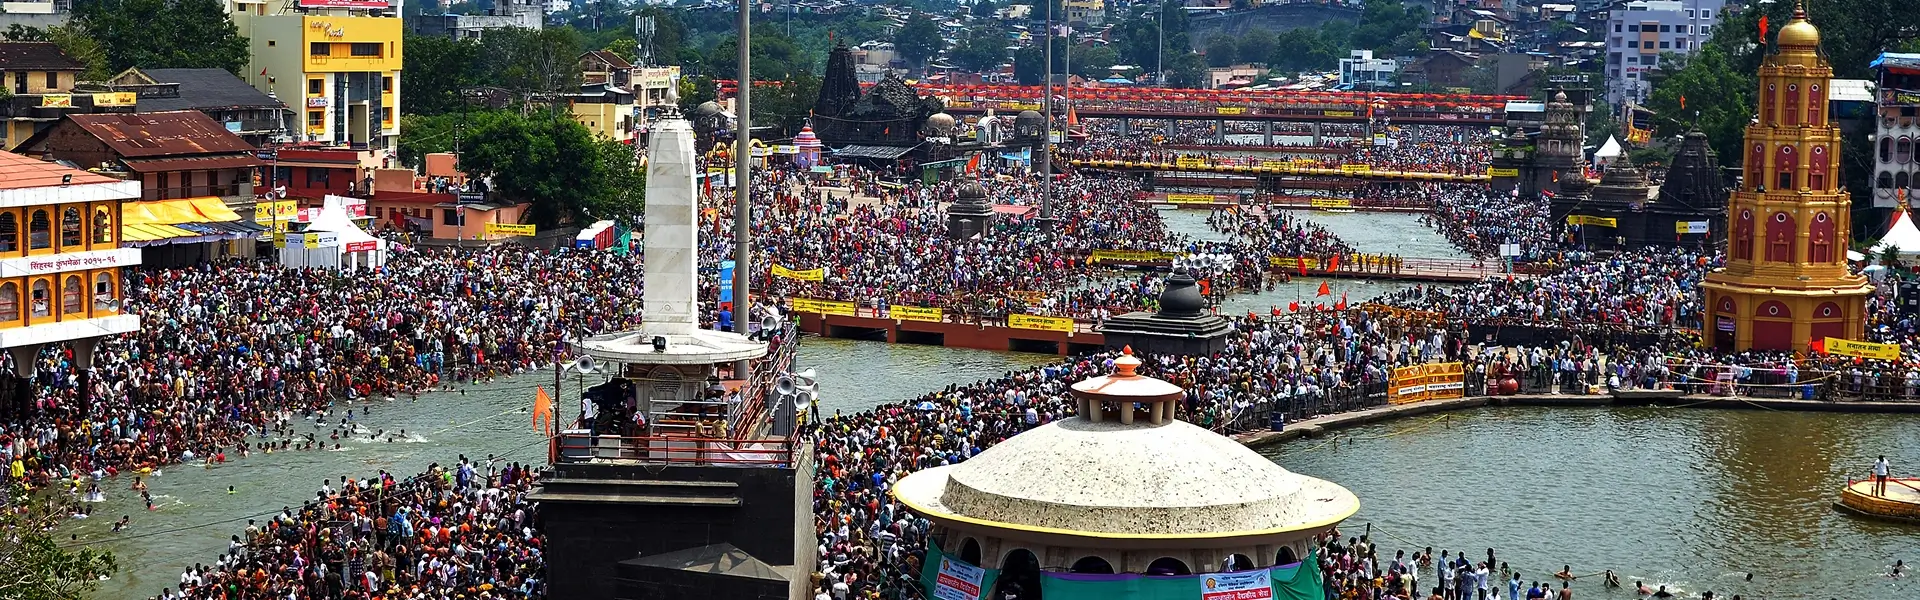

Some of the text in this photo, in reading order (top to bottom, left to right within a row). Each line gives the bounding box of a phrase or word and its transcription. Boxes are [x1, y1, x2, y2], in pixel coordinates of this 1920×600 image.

[30, 255, 116, 270] सिंहस्थ कुंभमेळा २०१५-१६
